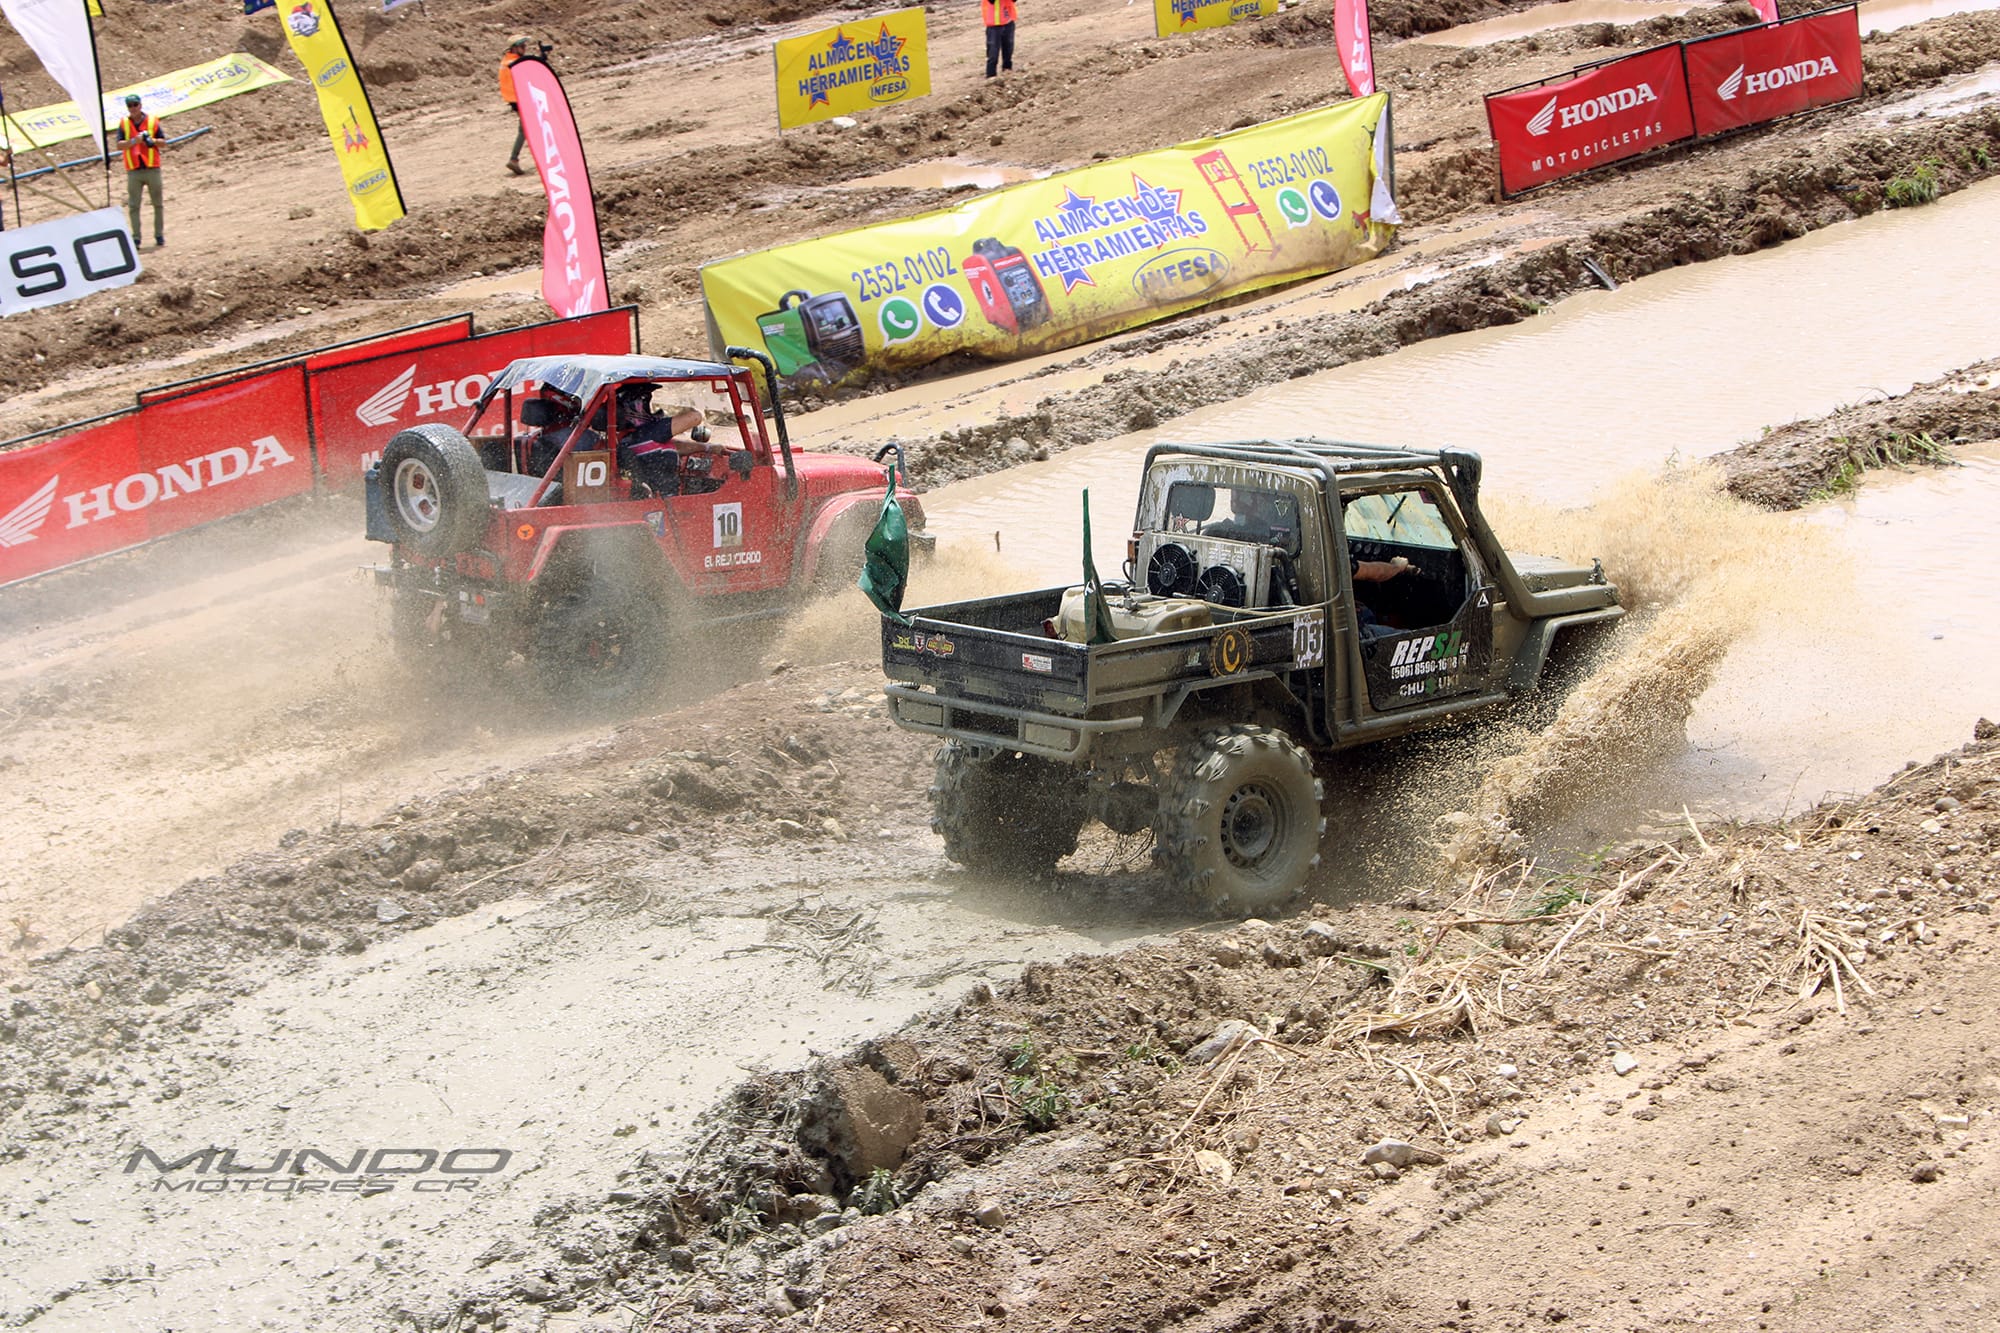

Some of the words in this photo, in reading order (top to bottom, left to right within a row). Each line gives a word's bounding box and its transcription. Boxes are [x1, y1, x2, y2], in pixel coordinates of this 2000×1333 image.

[1230, 2, 1260, 17] INFESA
[319, 60, 347, 84] INFESA
[808, 40, 876, 71] ALMACEN
[879, 35, 899, 56] DE
[798, 55, 910, 96] HERRAMIENTAS
[870, 80, 907, 98] INFESA
[1744, 56, 1839, 95] HONDA
[27, 113, 83, 132] INFES
[1558, 82, 1658, 129] HONDA
[1247, 146, 1335, 189] 2552-0102
[1531, 121, 1663, 173] MOTOCICLETAS
[1033, 195, 1144, 243] ALMACEN
[1139, 186, 1175, 213] DE
[1032, 210, 1207, 278] HERRAMIENTAS
[0, 229, 136, 303] SO
[851, 246, 958, 302] 2552-0102
[1139, 252, 1226, 293] INFESA
[62, 434, 295, 530] HONDA
[576, 461, 607, 487] 10
[716, 511, 738, 537] 10
[1390, 630, 1464, 667] REPSA
